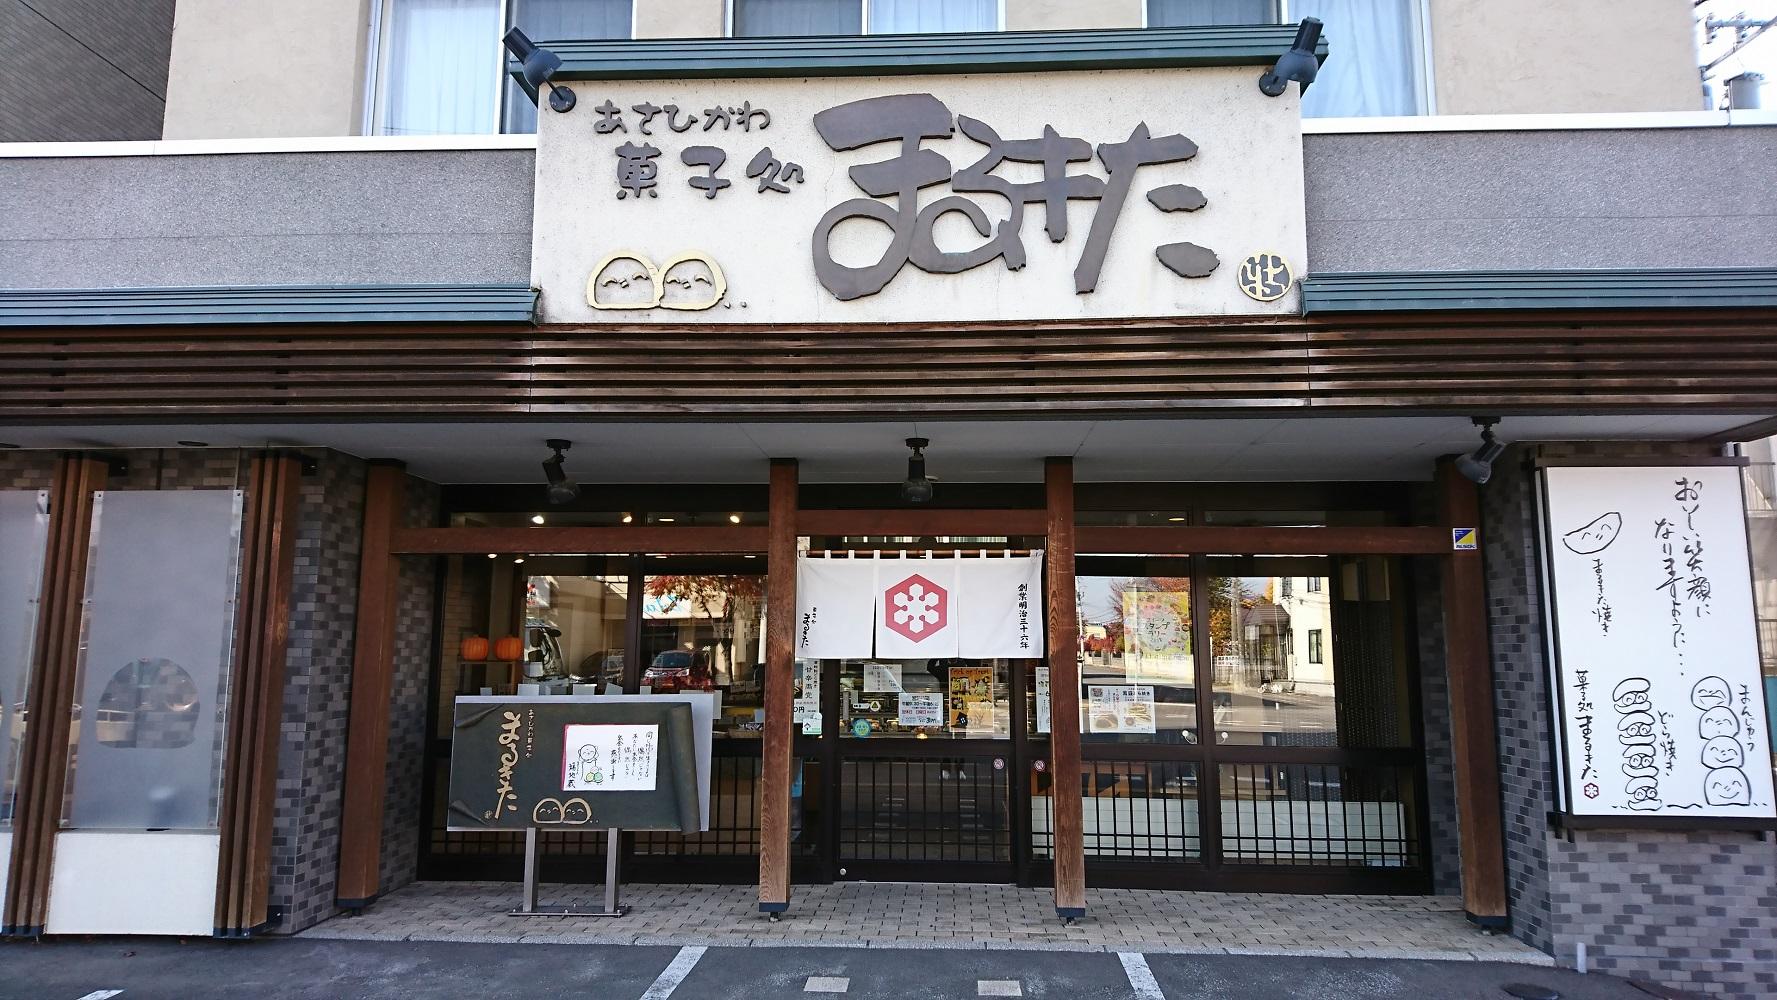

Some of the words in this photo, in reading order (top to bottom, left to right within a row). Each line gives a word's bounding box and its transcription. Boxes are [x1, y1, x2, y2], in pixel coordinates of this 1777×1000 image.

[614, 140, 805, 200] 菓子処
[812, 92, 1221, 303] まるきた
[1018, 583, 1030, 649] 創業明治三十六年
[495, 711, 521, 820] まるきた
